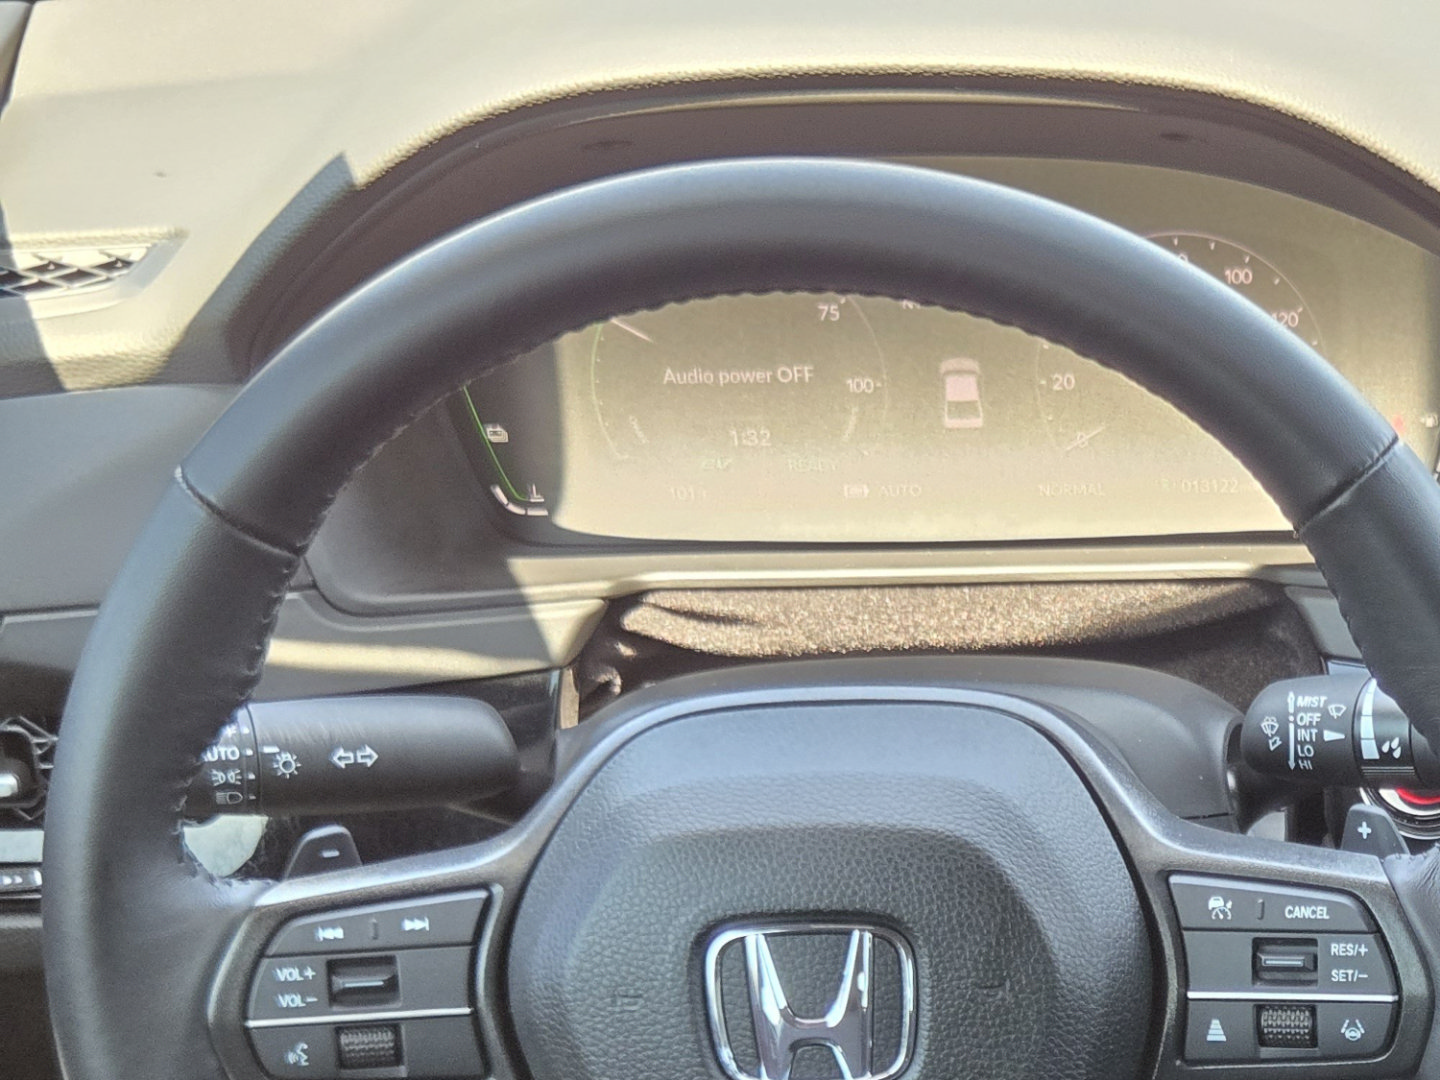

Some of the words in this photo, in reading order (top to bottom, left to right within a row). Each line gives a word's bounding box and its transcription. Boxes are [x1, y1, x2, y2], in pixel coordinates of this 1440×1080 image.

[1224, 269, 1252, 284] 100
[818, 304, 840, 321] 75
[663, 367, 713, 385] Audio
[719, 369, 772, 387] power
[777, 366, 814, 383] OFF
[1052, 373, 1075, 390] 20
[846, 378, 874, 393] 100
[729, 430, 772, 446] 1:32
[1038, 483, 1106, 498] NORMAL
[1297, 696, 1326, 708] MIST
[1297, 713, 1320, 726] OFF
[1297, 729, 1318, 742] INT
[1298, 746, 1314, 757] LO
[1299, 759, 1314, 771] HI
[1285, 906, 1330, 920] CANCEL
[1331, 943, 1368, 957] RES/+
